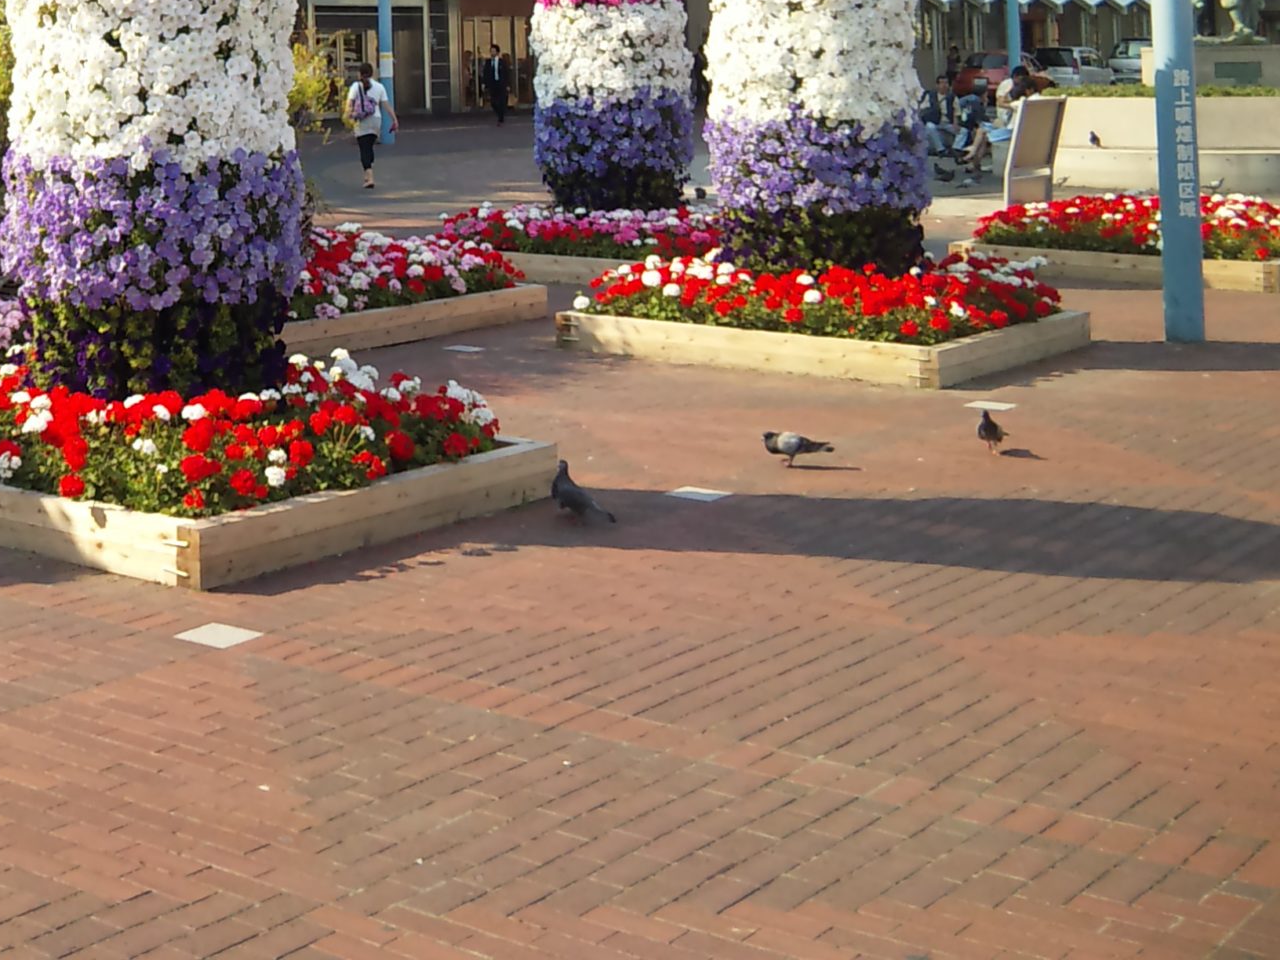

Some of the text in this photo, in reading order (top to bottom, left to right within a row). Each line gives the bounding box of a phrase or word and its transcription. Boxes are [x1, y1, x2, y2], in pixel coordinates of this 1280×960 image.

[1173, 69, 1197, 218] 路上喫煙制限区域
